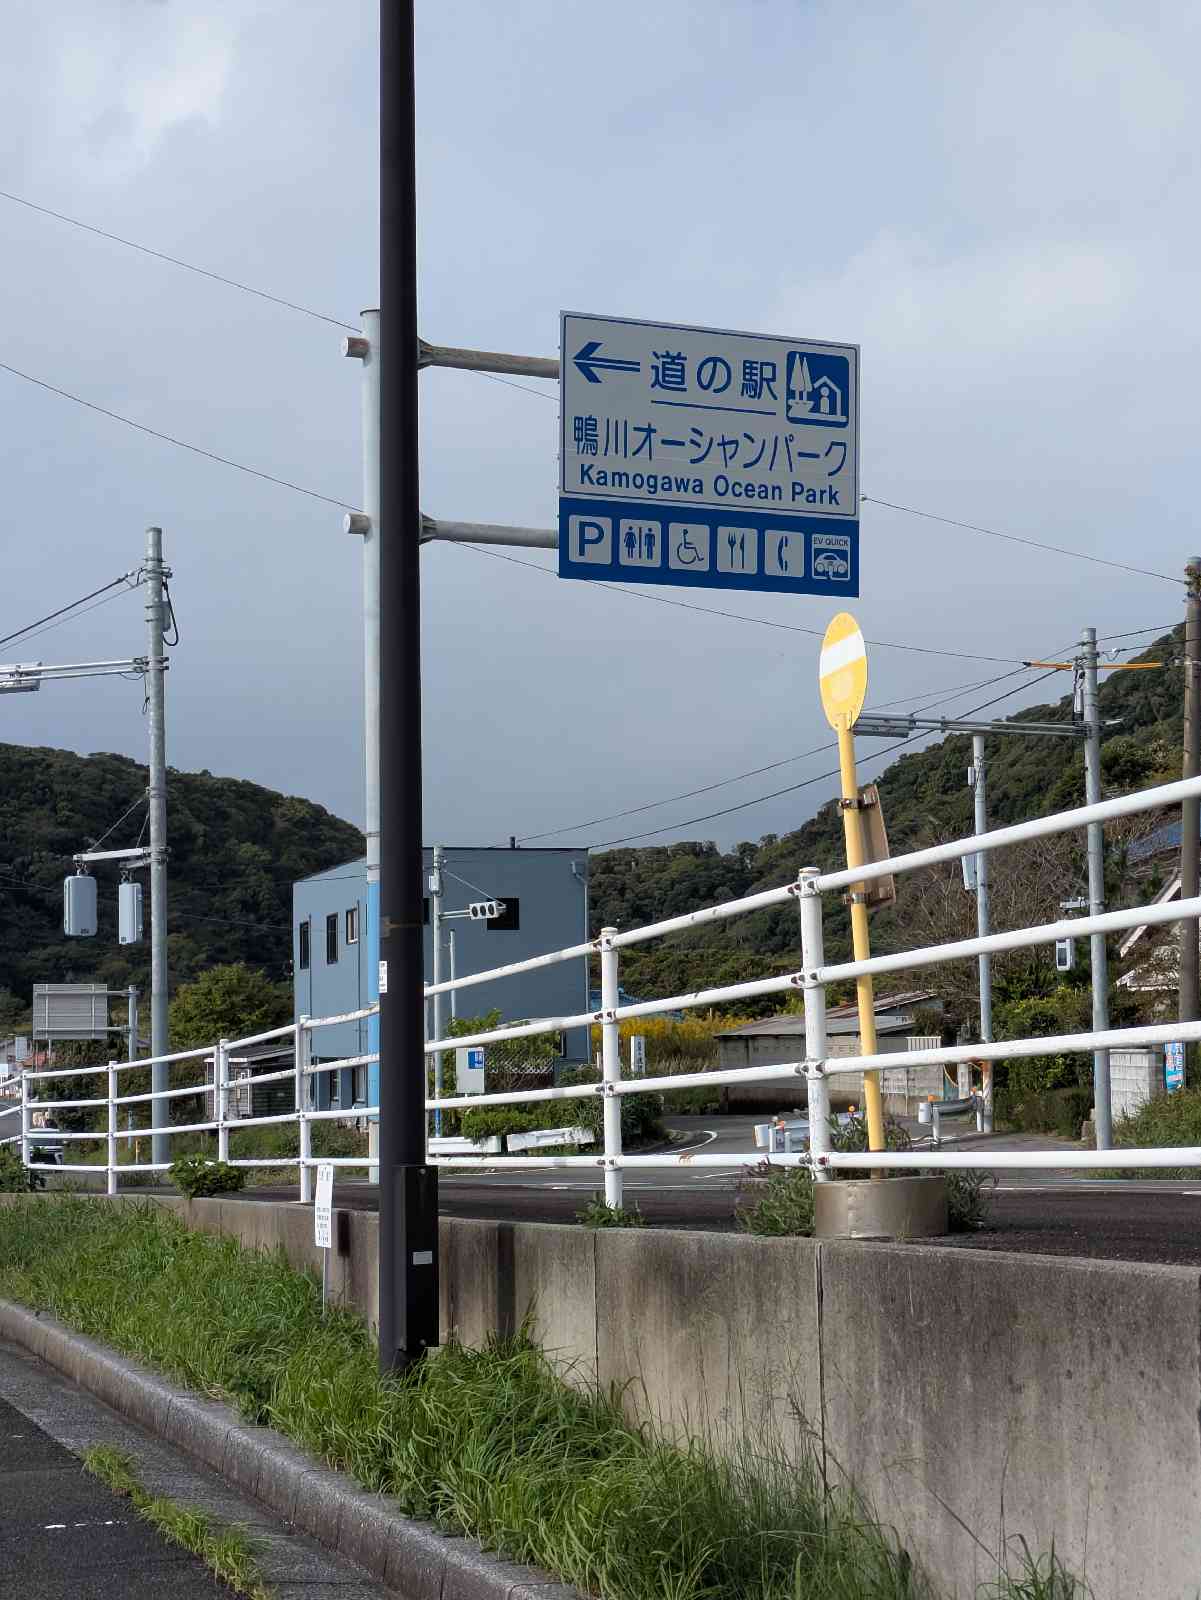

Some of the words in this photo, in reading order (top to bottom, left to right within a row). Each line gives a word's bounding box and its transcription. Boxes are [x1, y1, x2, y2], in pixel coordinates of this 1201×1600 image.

[650, 351, 778, 401] 道の駅
[573, 415, 847, 477] 鴨川オーシャンパーク
[580, 464, 704, 494] Kamogawa
[713, 475, 783, 501] Ocean
[791, 482, 841, 506] Park
[578, 521, 605, 557] P
[813, 536, 824, 545] EV
[825, 538, 849, 547] QUICK
